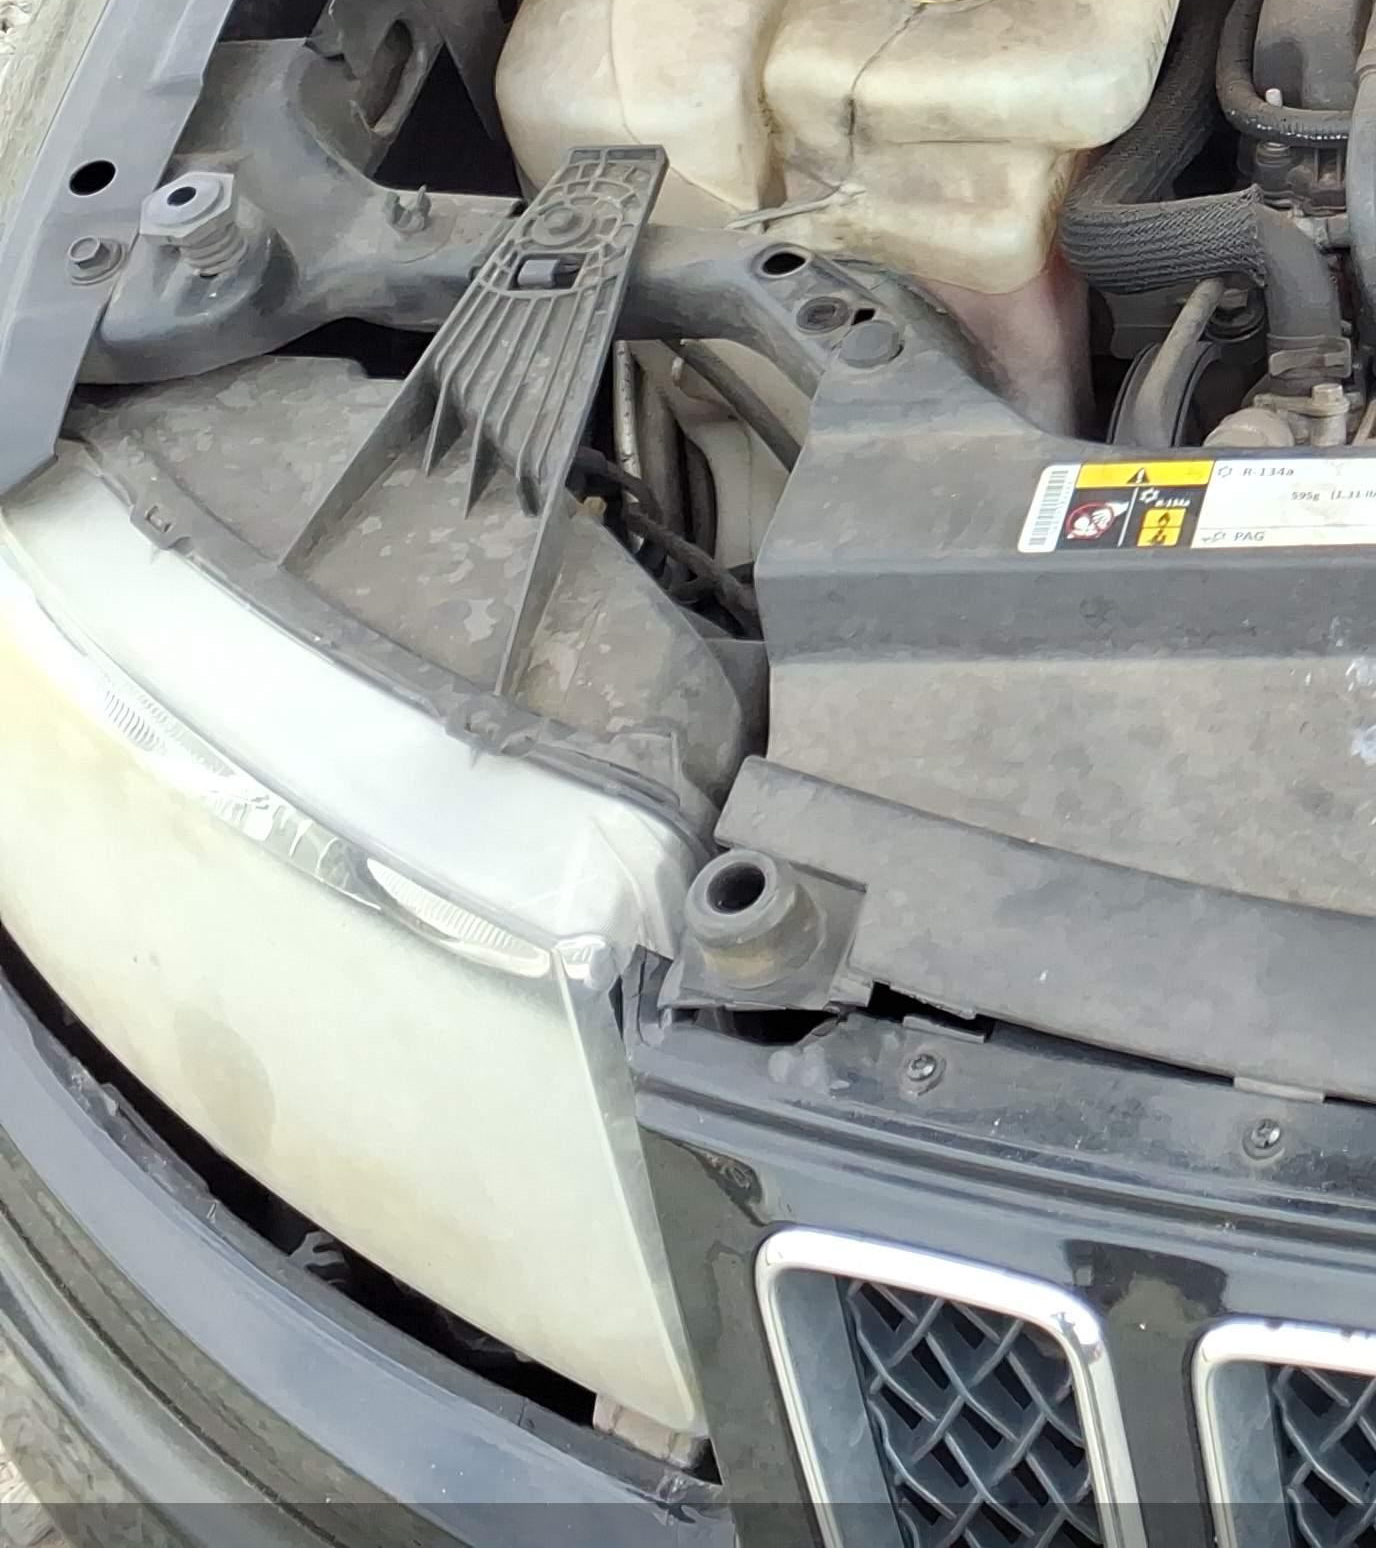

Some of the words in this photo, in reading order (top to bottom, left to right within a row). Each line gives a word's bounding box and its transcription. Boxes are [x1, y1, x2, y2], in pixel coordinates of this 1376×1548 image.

[1242, 467, 1295, 477] R-134a
[1290, 490, 1321, 501] 595g
[1234, 531, 1266, 542] PAG
